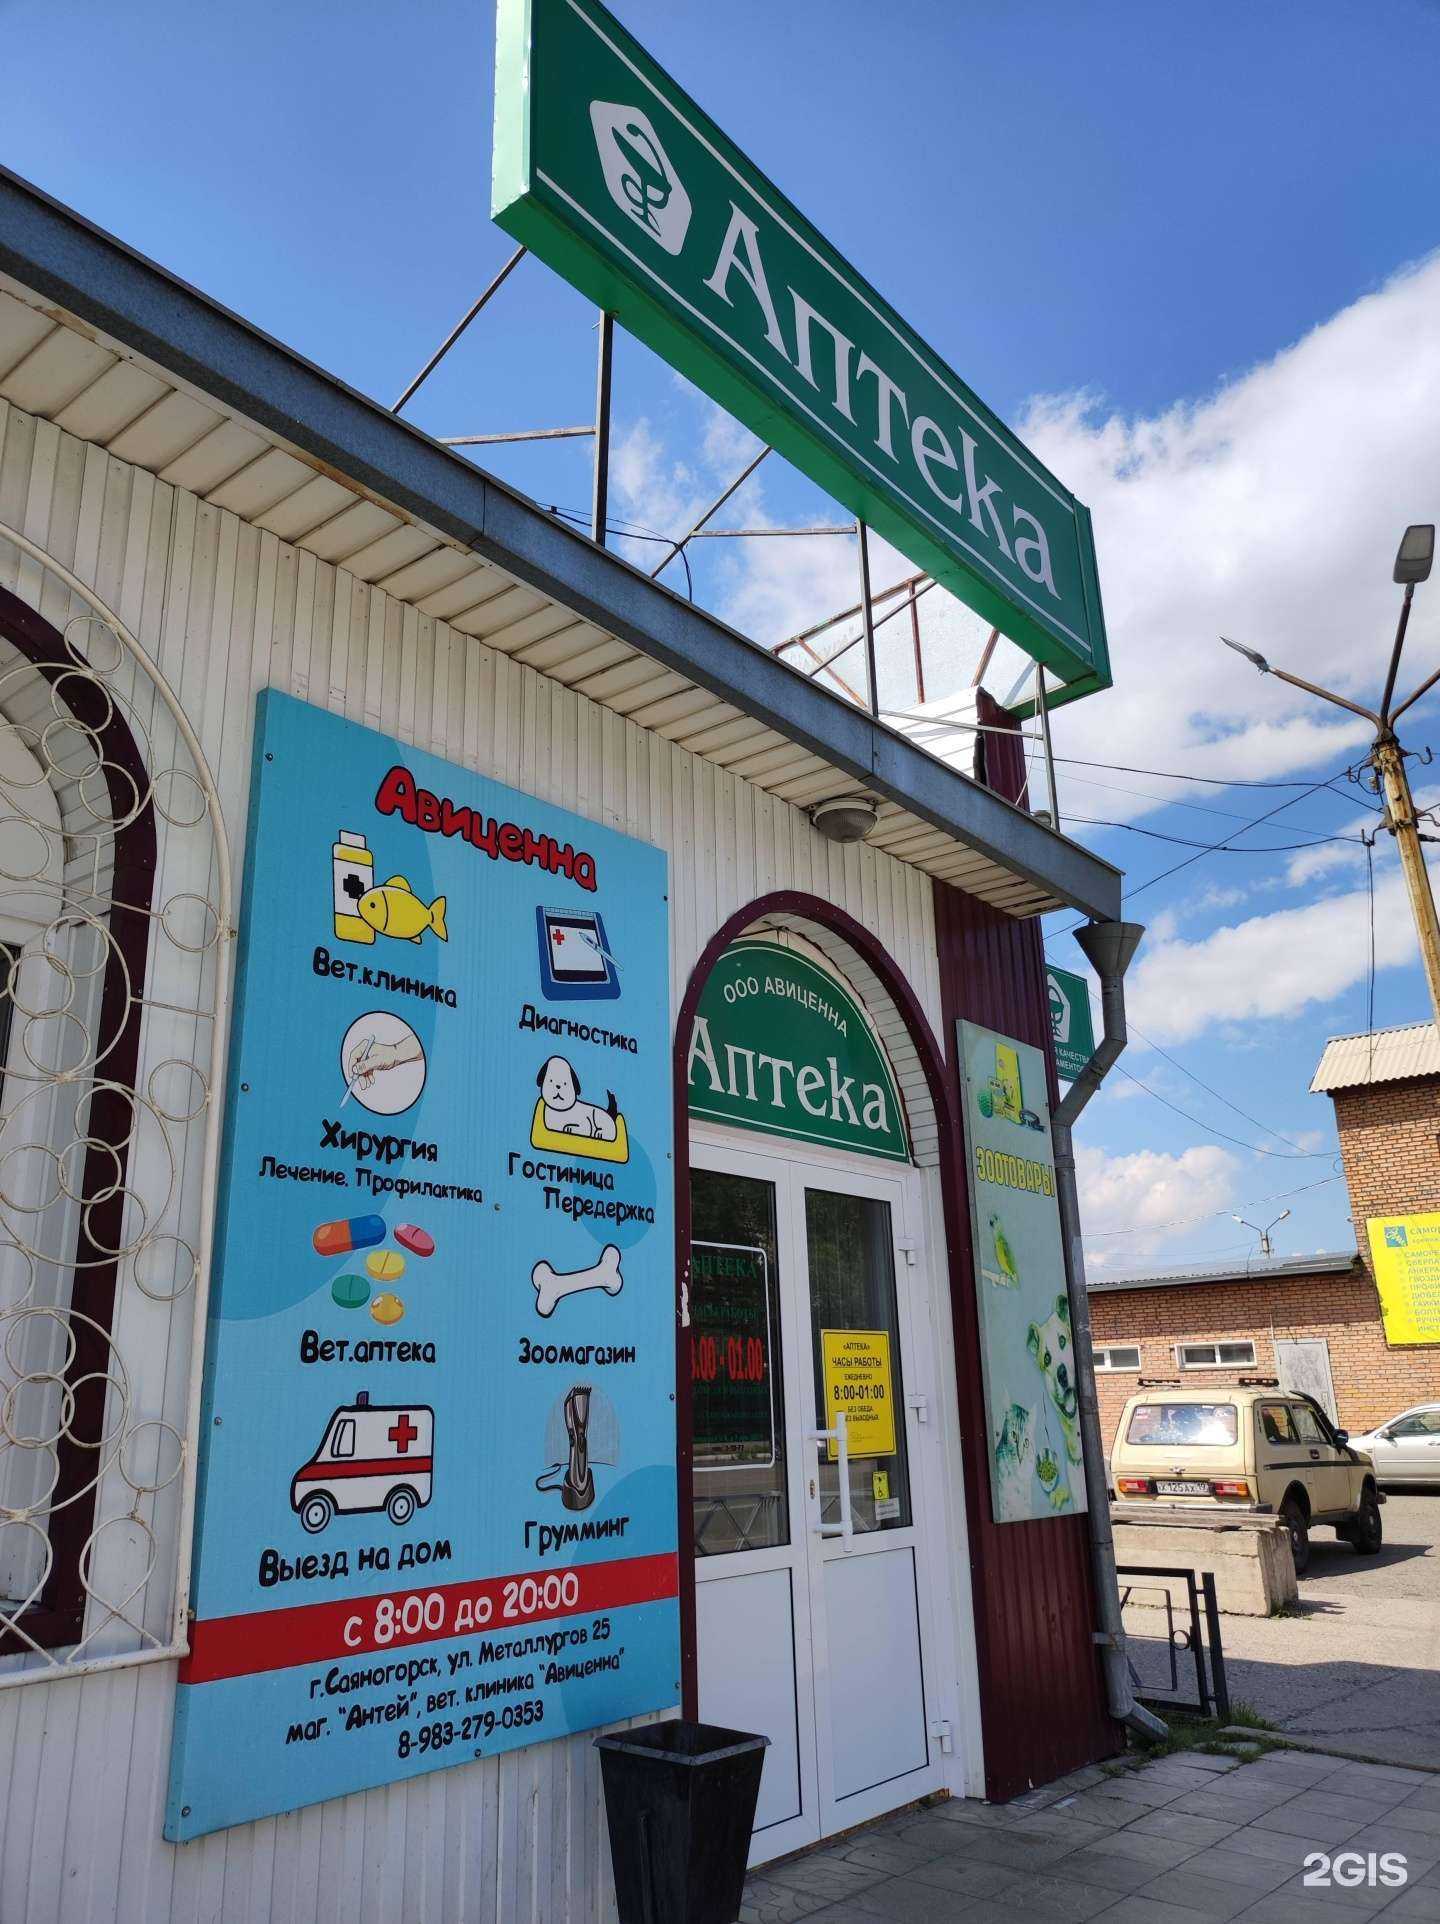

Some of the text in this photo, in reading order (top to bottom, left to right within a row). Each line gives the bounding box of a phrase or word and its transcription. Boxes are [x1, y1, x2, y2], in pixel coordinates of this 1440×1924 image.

[702, 200, 1060, 600] Аптека
[375, 766, 598, 892] Авиценна
[313, 947, 457, 1008] Вет.клиника
[519, 1005, 638, 1054] Диагностика
[724, 976, 848, 1038] ООО АВИЦЕННА
[688, 1015, 891, 1134] Аптека
[319, 1119, 438, 1165] Хирургия
[259, 1157, 483, 1203] Лечение. Профилактика
[508, 1152, 614, 1190] Гостиница
[976, 1145, 1056, 1198] ЗООТОВАРЫ
[543, 1187, 655, 1224] Передержка
[300, 1330, 436, 1364] Вет.аптека
[518, 1338, 636, 1365] Зоомагазин
[832, 1357, 882, 1367] ЧАСЫ РАБОТЫ
[833, 1384, 885, 1401] 8:00-01:00
[524, 1515, 630, 1556] Грумминг
[259, 1539, 452, 1587] Выезд на дом
[344, 1572, 580, 1647] с 8:00 до 20:00
[448, 1651, 473, 1675] ул.
[479, 1628, 588, 1664] Металлургов
[592, 1617, 611, 1640] 25
[286, 1717, 331, 1745] маг.
[427, 1692, 460, 1713] вет.
[465, 1673, 534, 1701] клиника
[398, 1700, 545, 1758] 8-983-279-0353
